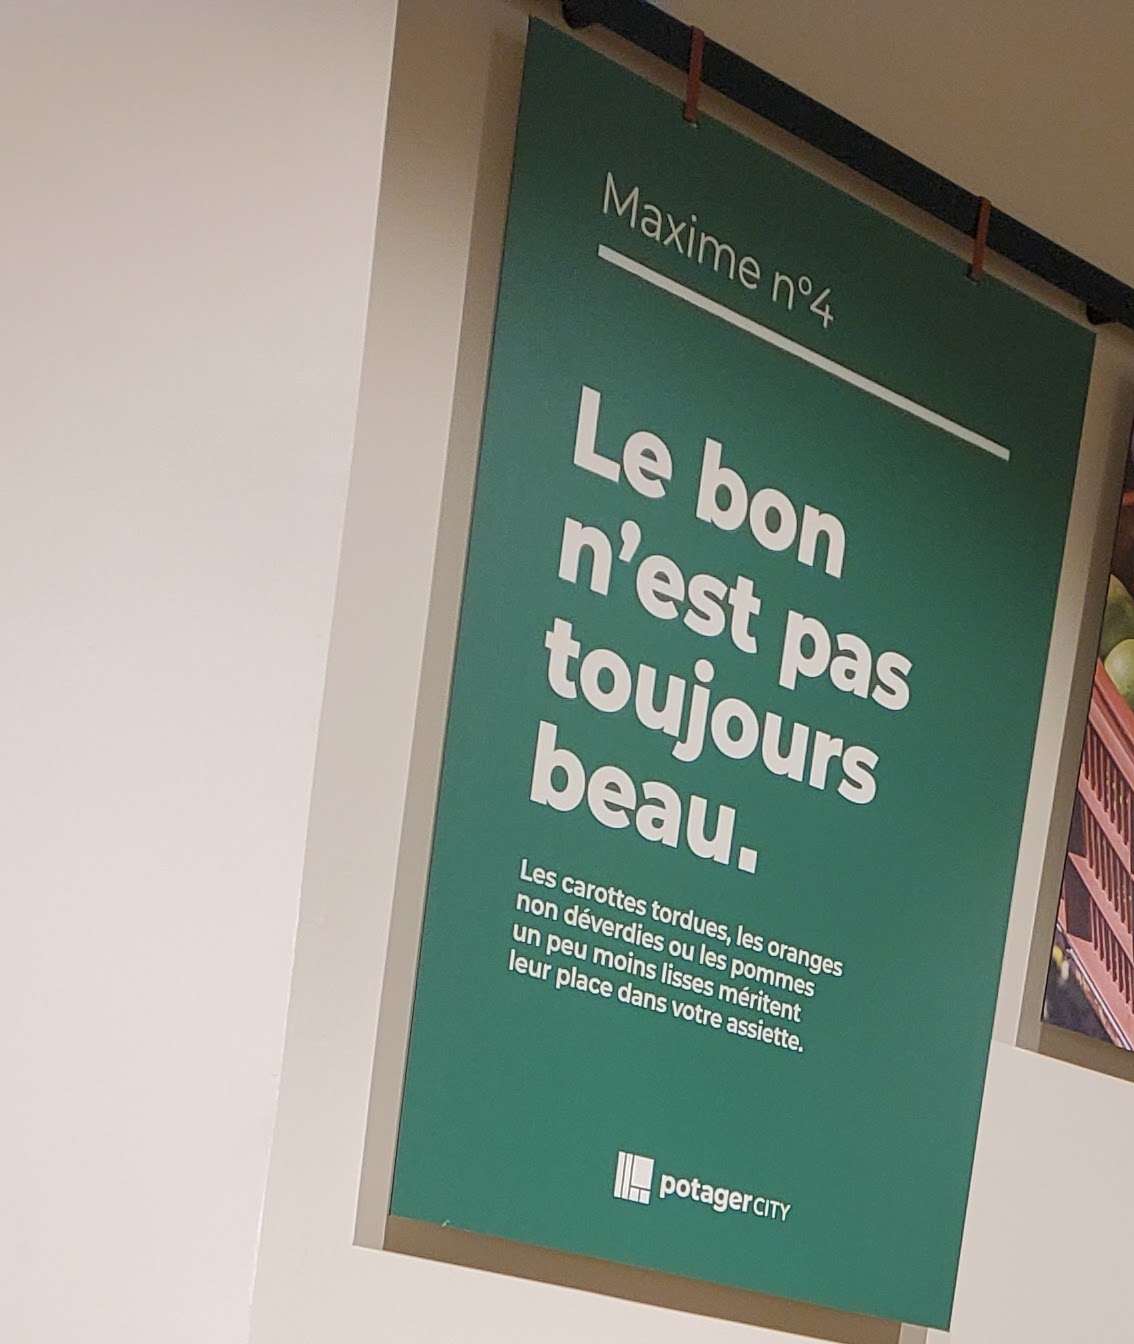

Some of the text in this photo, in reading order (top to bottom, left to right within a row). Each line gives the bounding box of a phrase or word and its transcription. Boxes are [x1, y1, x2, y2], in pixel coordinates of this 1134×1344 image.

[603, 172, 761, 290] Maxime
[574, 386, 846, 578] Le bon
[558, 518, 913, 711] n’est pas
[545, 618, 879, 804] toujours
[530, 721, 758, 874] beau.
[513, 923, 802, 1023] un peu moins lisses méritent
[516, 893, 815, 997] non déverdies ou les pommes
[521, 859, 843, 977] Les carottes tordues, les oranges
[509, 948, 803, 1053] leur place dans votre assiette.
[659, 1174, 791, 1221] potagerCITY
